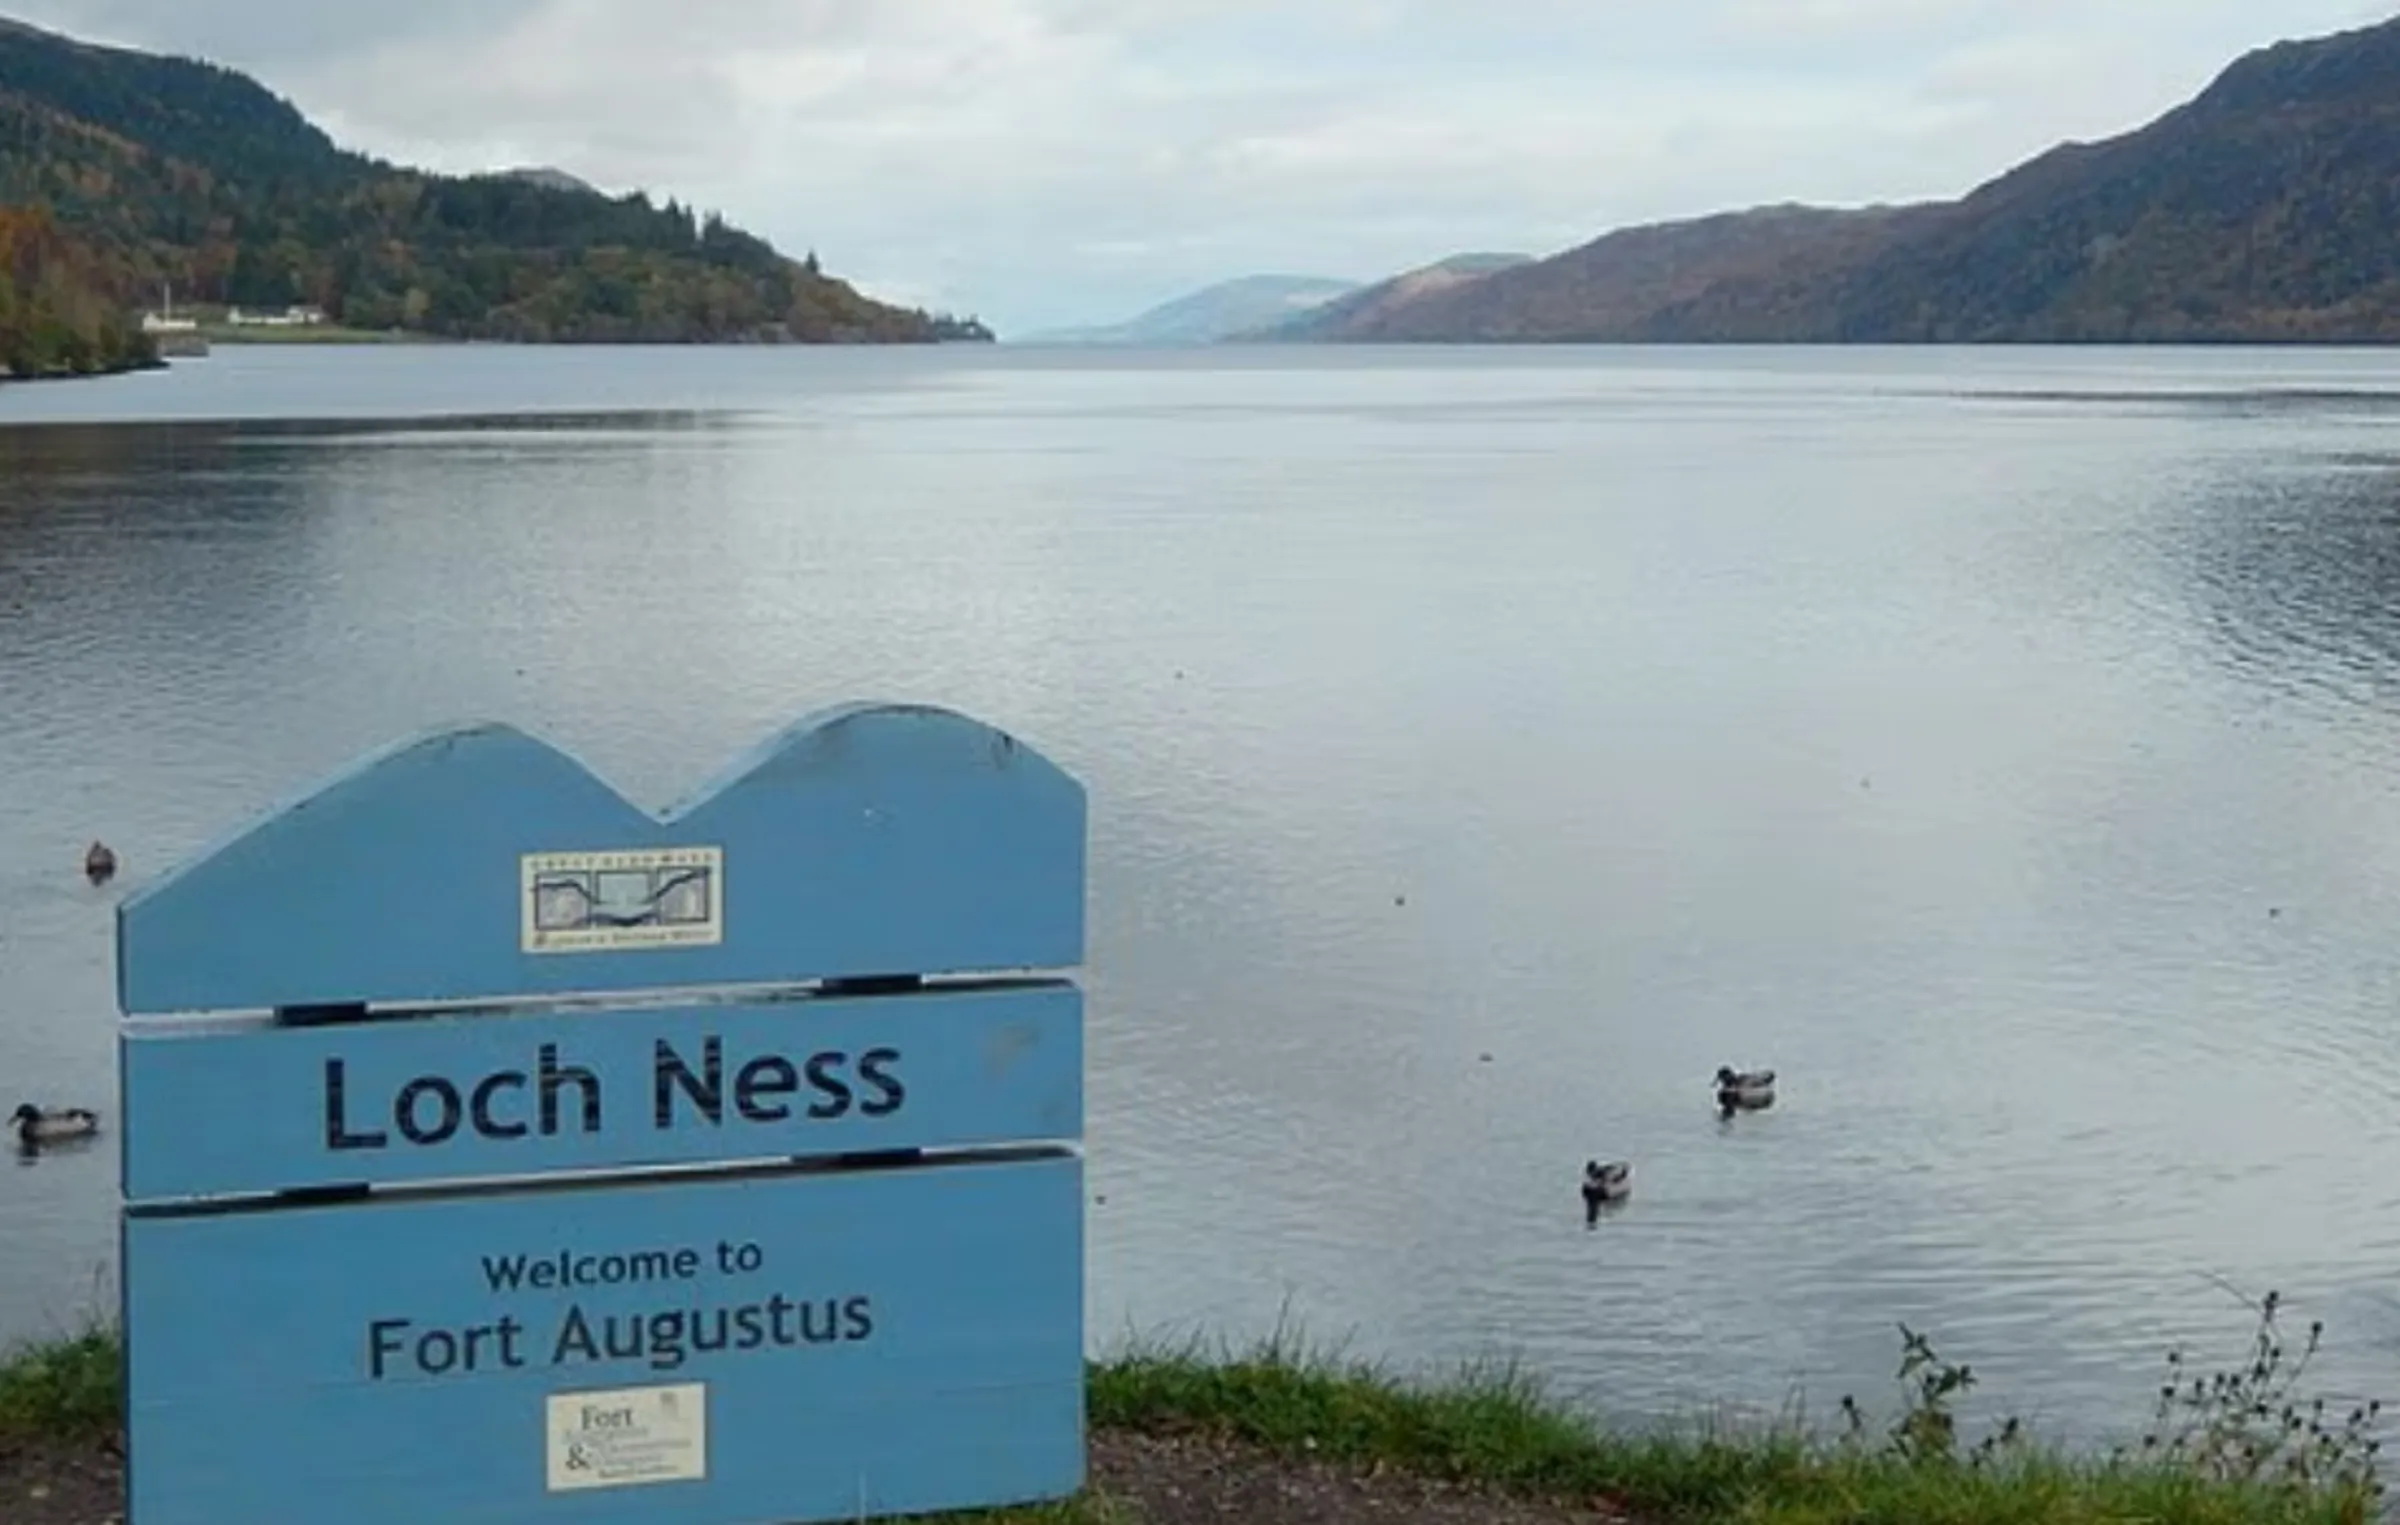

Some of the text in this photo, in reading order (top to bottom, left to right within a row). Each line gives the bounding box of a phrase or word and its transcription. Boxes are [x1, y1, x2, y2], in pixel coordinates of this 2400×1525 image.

[326, 1035, 905, 1149] Loch Ness
[482, 1239, 764, 1291] Welcome to
[369, 1295, 873, 1379] Fort Augustus
[581, 1404, 634, 1430] Fort
[565, 1442, 592, 1470] &
